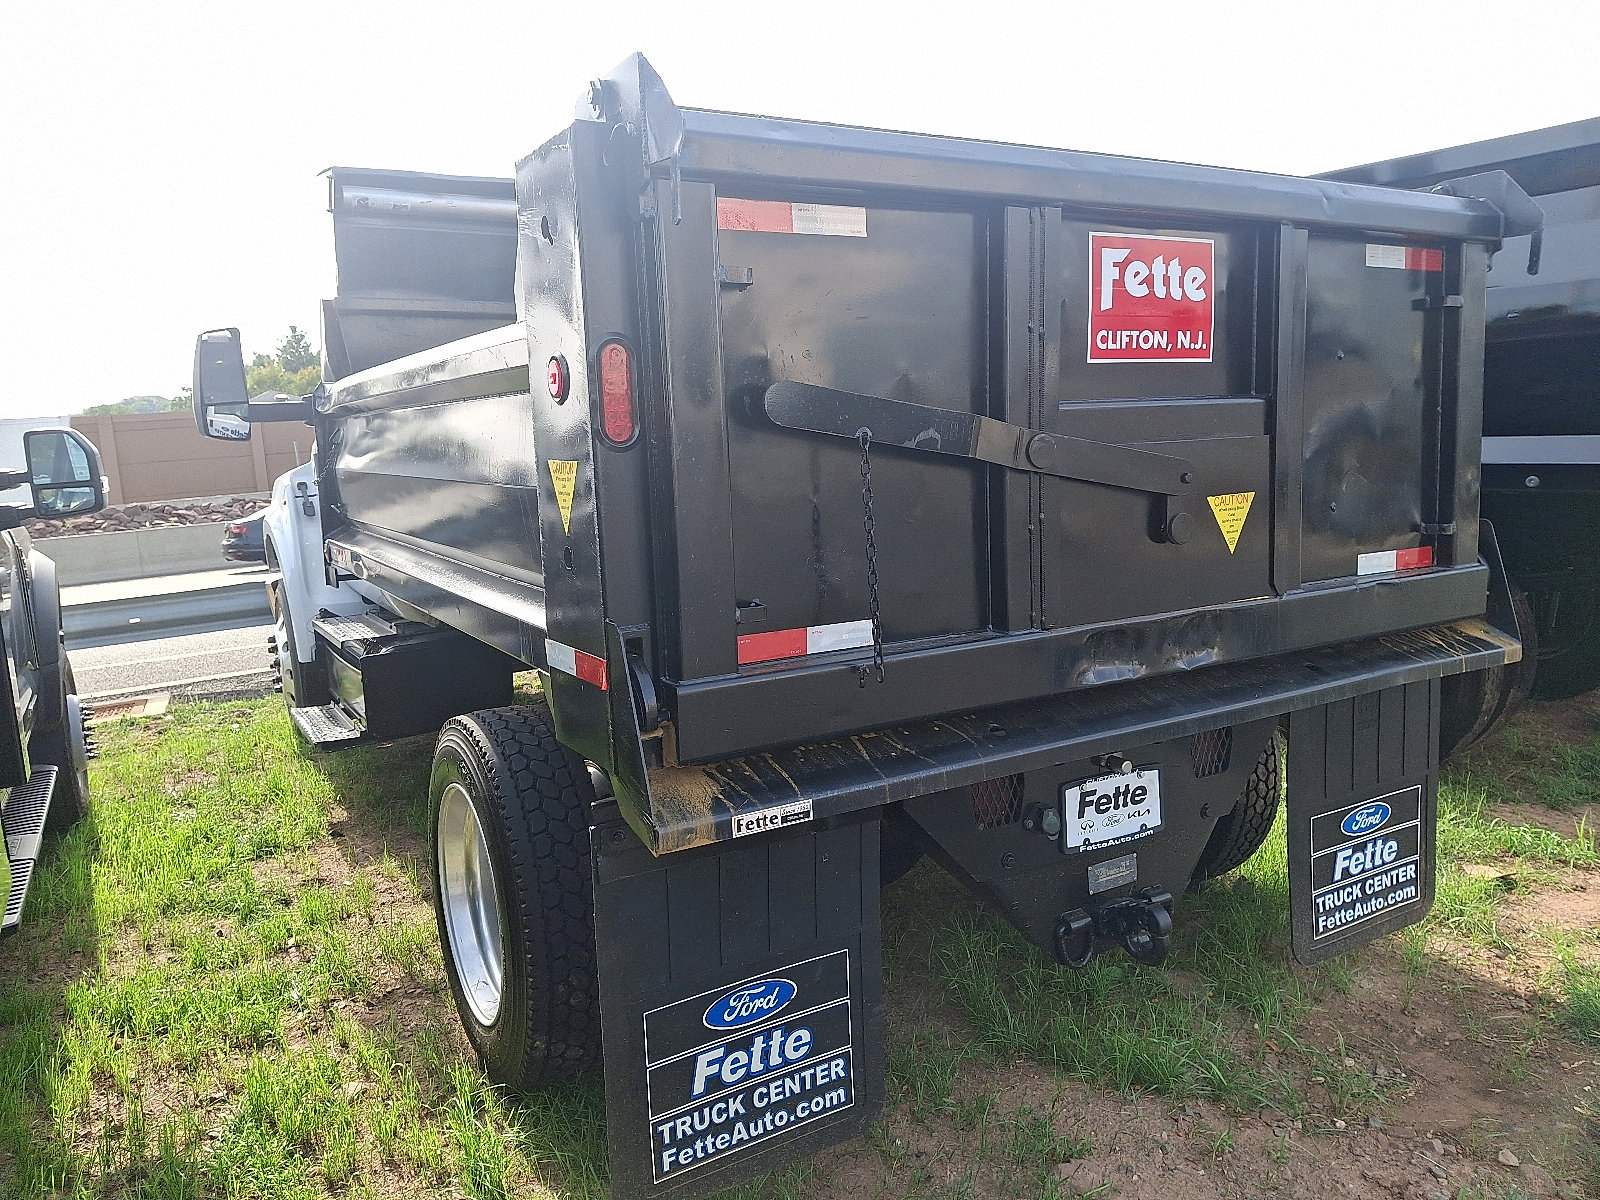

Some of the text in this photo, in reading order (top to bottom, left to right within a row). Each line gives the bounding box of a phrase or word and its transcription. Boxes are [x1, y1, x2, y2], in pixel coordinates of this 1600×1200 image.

[1100, 247, 1207, 312] Fette
[1096, 329, 1207, 352] CLIFTON, N.J.
[552, 461, 574, 475] CAUTION
[1213, 493, 1249, 507] CAUTION
[1077, 783, 1148, 819] Fette
[1351, 807, 1383, 831] Ford
[736, 813, 780, 834] Fette
[1080, 829, 1154, 852] FetteAuto.com
[1333, 838, 1398, 882] Fette
[1315, 864, 1417, 913] TRUCK CENTER
[1317, 885, 1416, 933] FetteAuto.com
[723, 985, 780, 1022] Ford
[691, 1028, 812, 1097] Fette
[657, 1058, 847, 1145] TRUCK CENTER
[661, 1086, 846, 1173] FetteAuto.com
